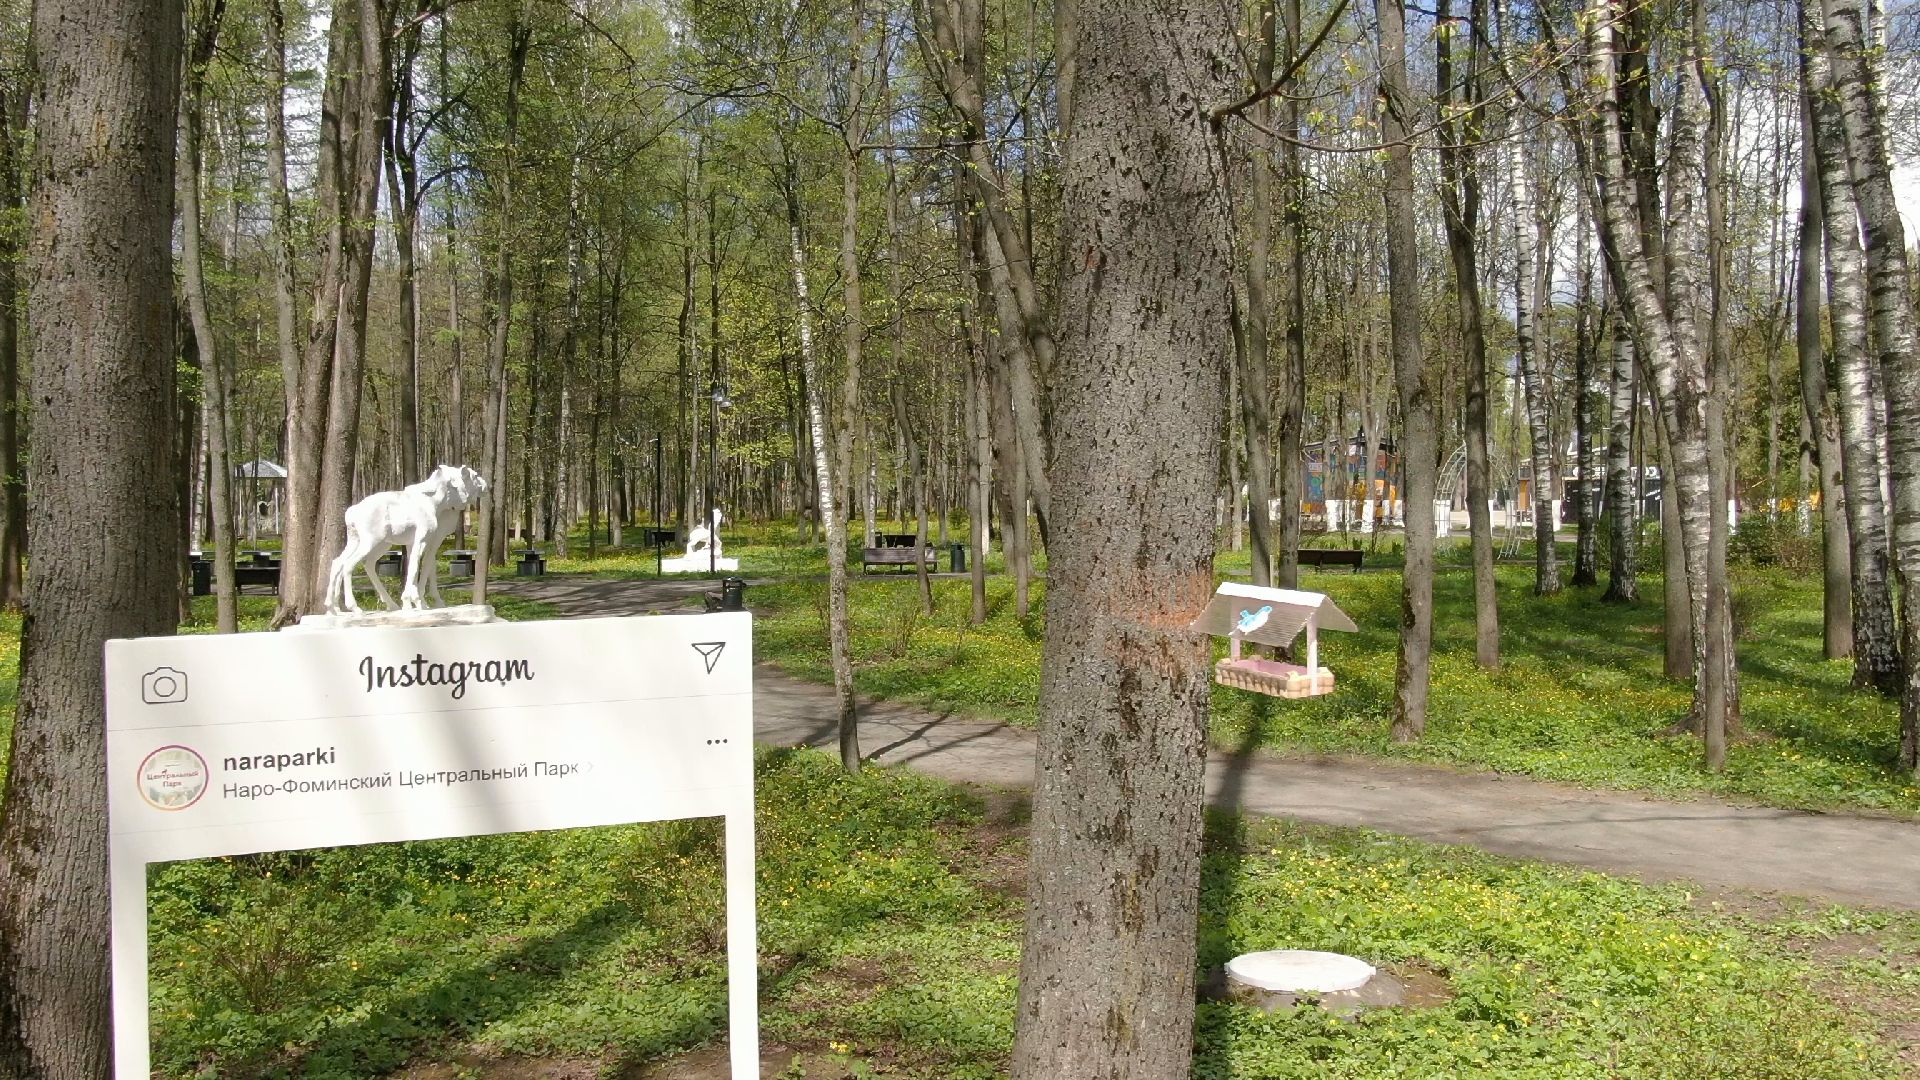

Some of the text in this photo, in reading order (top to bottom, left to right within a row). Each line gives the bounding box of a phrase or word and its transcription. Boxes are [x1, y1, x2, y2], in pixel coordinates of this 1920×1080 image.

[358, 653, 536, 700] Instagram
[223, 746, 336, 772] naraparki
[223, 761, 580, 799] Наро-Фоминский Центральный Парк
